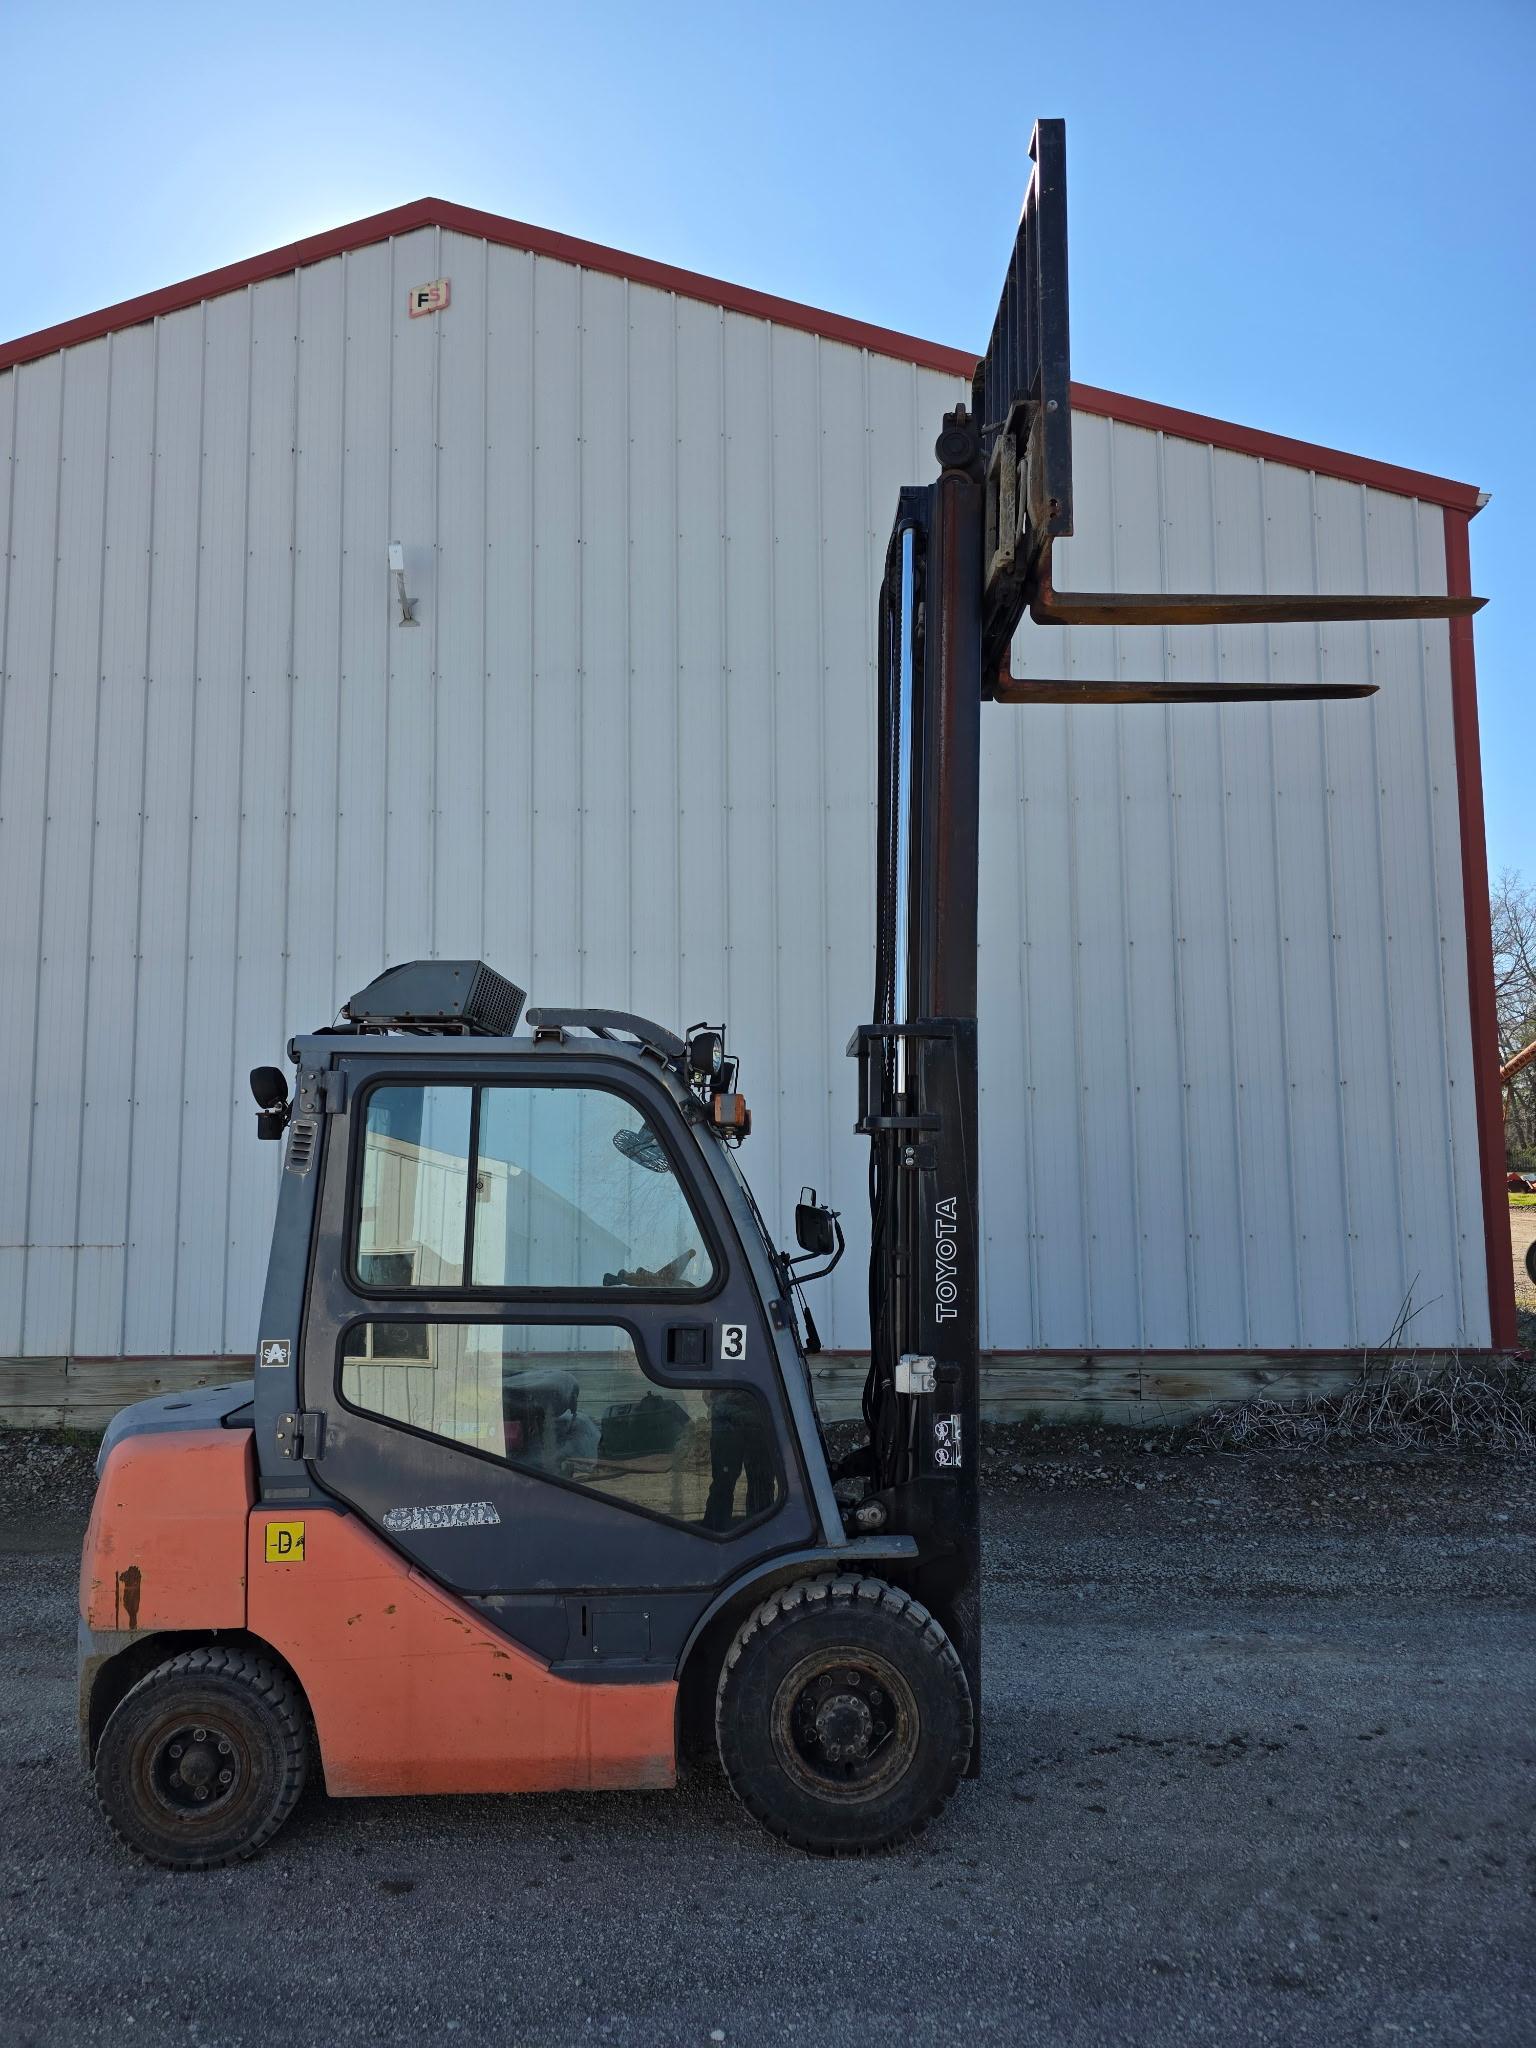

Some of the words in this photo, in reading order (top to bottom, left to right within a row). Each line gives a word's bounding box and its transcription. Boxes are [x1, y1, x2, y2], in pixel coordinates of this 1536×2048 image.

[936, 1197, 957, 1322] TOYOTA
[725, 1328, 743, 1357] 3
[414, 1503, 497, 1526] TOYOTA
